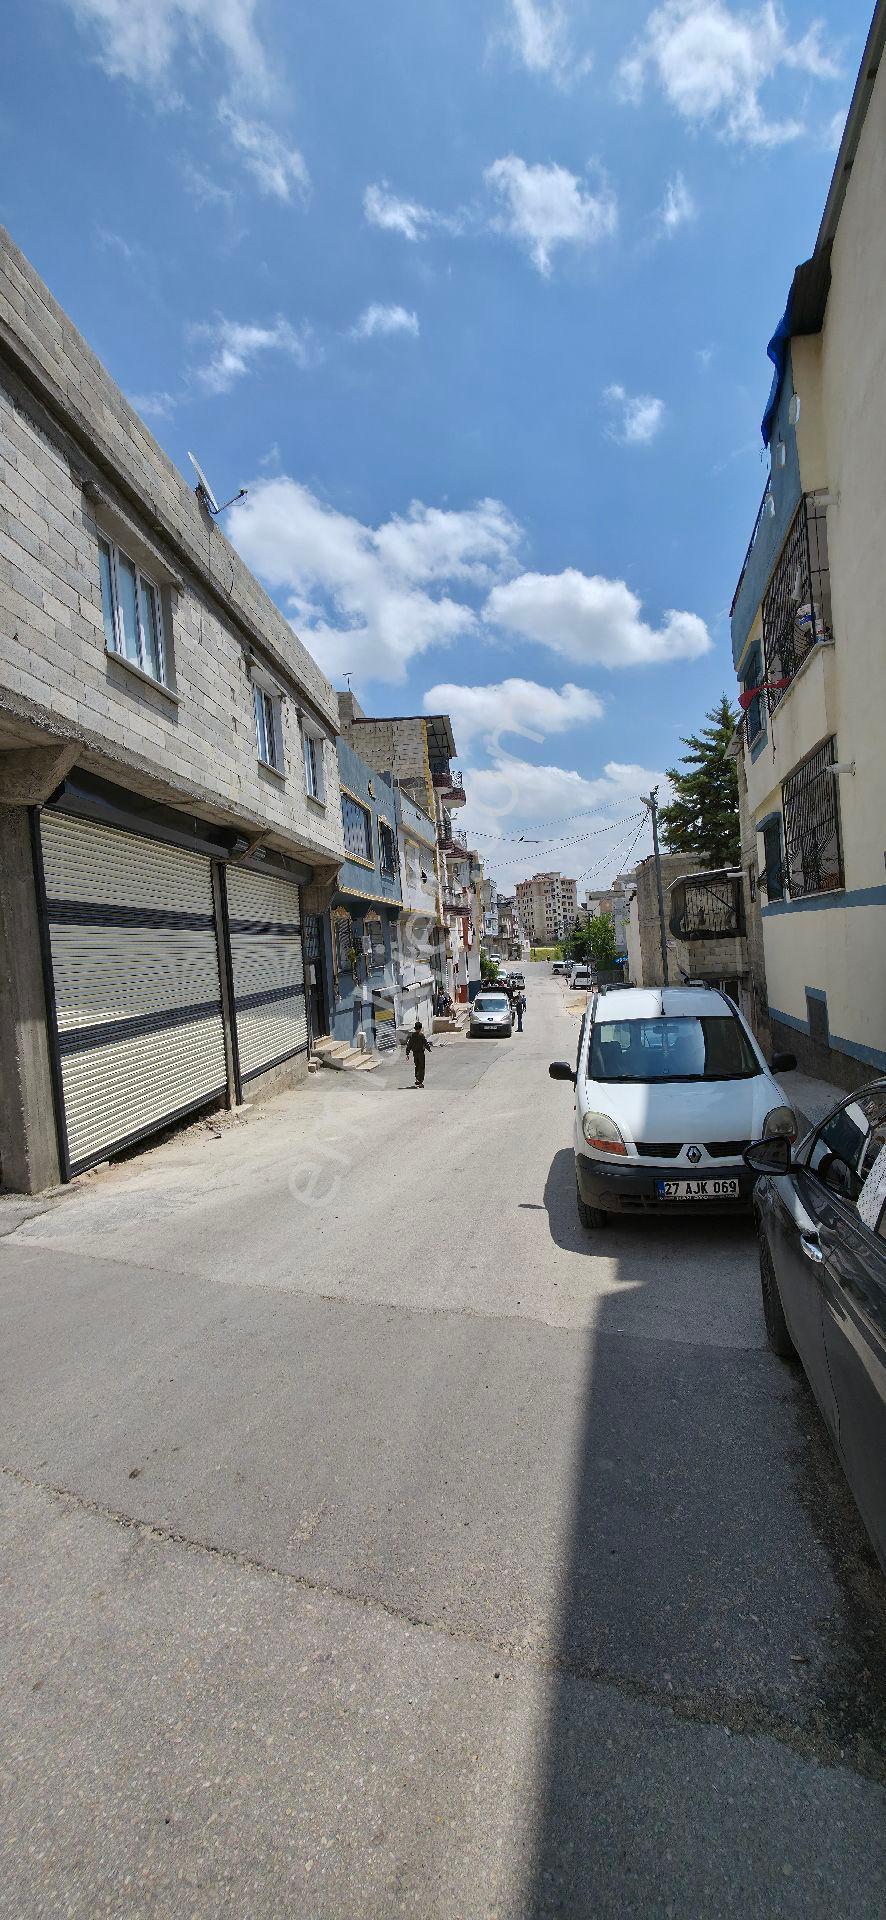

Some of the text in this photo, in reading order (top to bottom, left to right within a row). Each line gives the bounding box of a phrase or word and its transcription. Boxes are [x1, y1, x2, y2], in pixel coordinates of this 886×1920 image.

[665, 1183, 679, 1195] 27
[686, 1182, 708, 1194] AJK
[714, 1181, 736, 1193] 069
